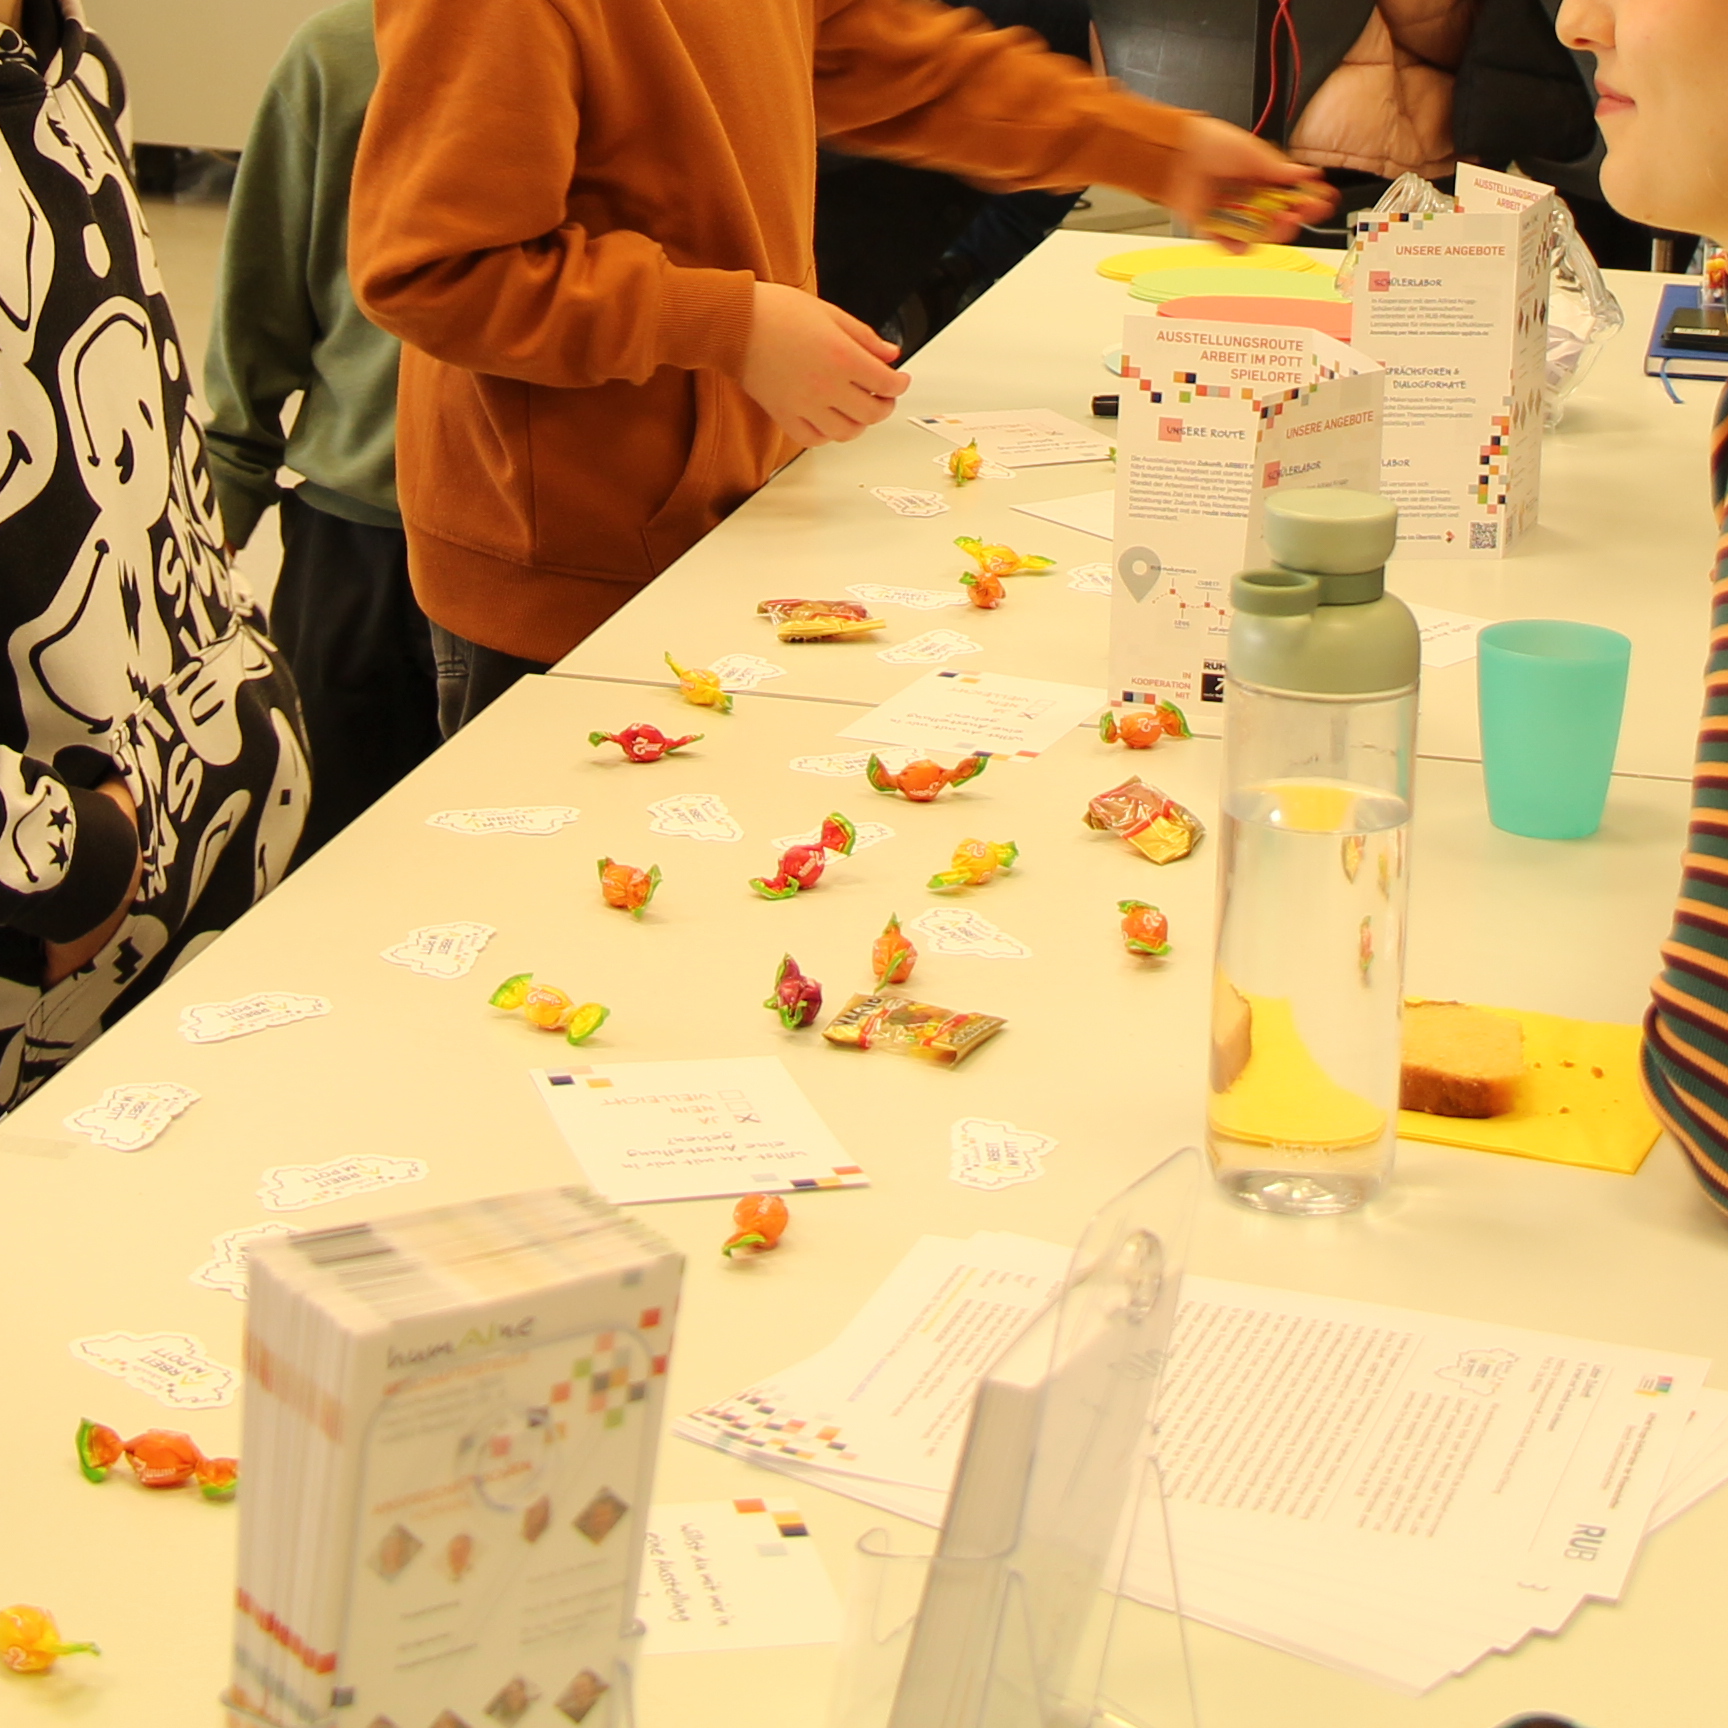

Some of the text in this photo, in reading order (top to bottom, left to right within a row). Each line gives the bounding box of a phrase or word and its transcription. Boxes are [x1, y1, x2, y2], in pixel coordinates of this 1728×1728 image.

[1474, 177, 1543, 201] AUSSTELLUNGSROU
[1496, 197, 1521, 211] ARBEIT
[1396, 245, 1506, 256] UNSERE ANGEBOTE
[1374, 277, 1442, 286] SCHÜLERLABOR
[1156, 330, 1303, 352] AUSSTELLUNGSROUTE
[1200, 350, 1303, 367] ARBEIT IM POTT
[1230, 369, 1302, 384] SPIELORTE
[1385, 365, 1452, 376] SPRÄCHSFOREN
[1393, 380, 1467, 389] DIALOGFORMATE
[1286, 410, 1374, 439] UNSERE ANGEBOTE
[1166, 425, 1246, 440] UNSERE ROUTE
[1131, 677, 1191, 690] KOOPERATION
[1182, 672, 1191, 680] IN
[1175, 691, 1190, 700] MIT
[906, 713, 989, 729] Ausstellung
[599, 1092, 712, 1106] VIELLEICHT
[670, 1105, 716, 1114] NEIN
[698, 1115, 720, 1125] JA
[667, 1131, 732, 1146] gehen?
[626, 1141, 785, 1158] eine Ausstellung
[151, 1347, 189, 1366] POTT
[138, 1355, 204, 1385] ARBEIT
[1564, 1523, 1607, 1563] RUB
[651, 1558, 691, 1622] Ausstellung
